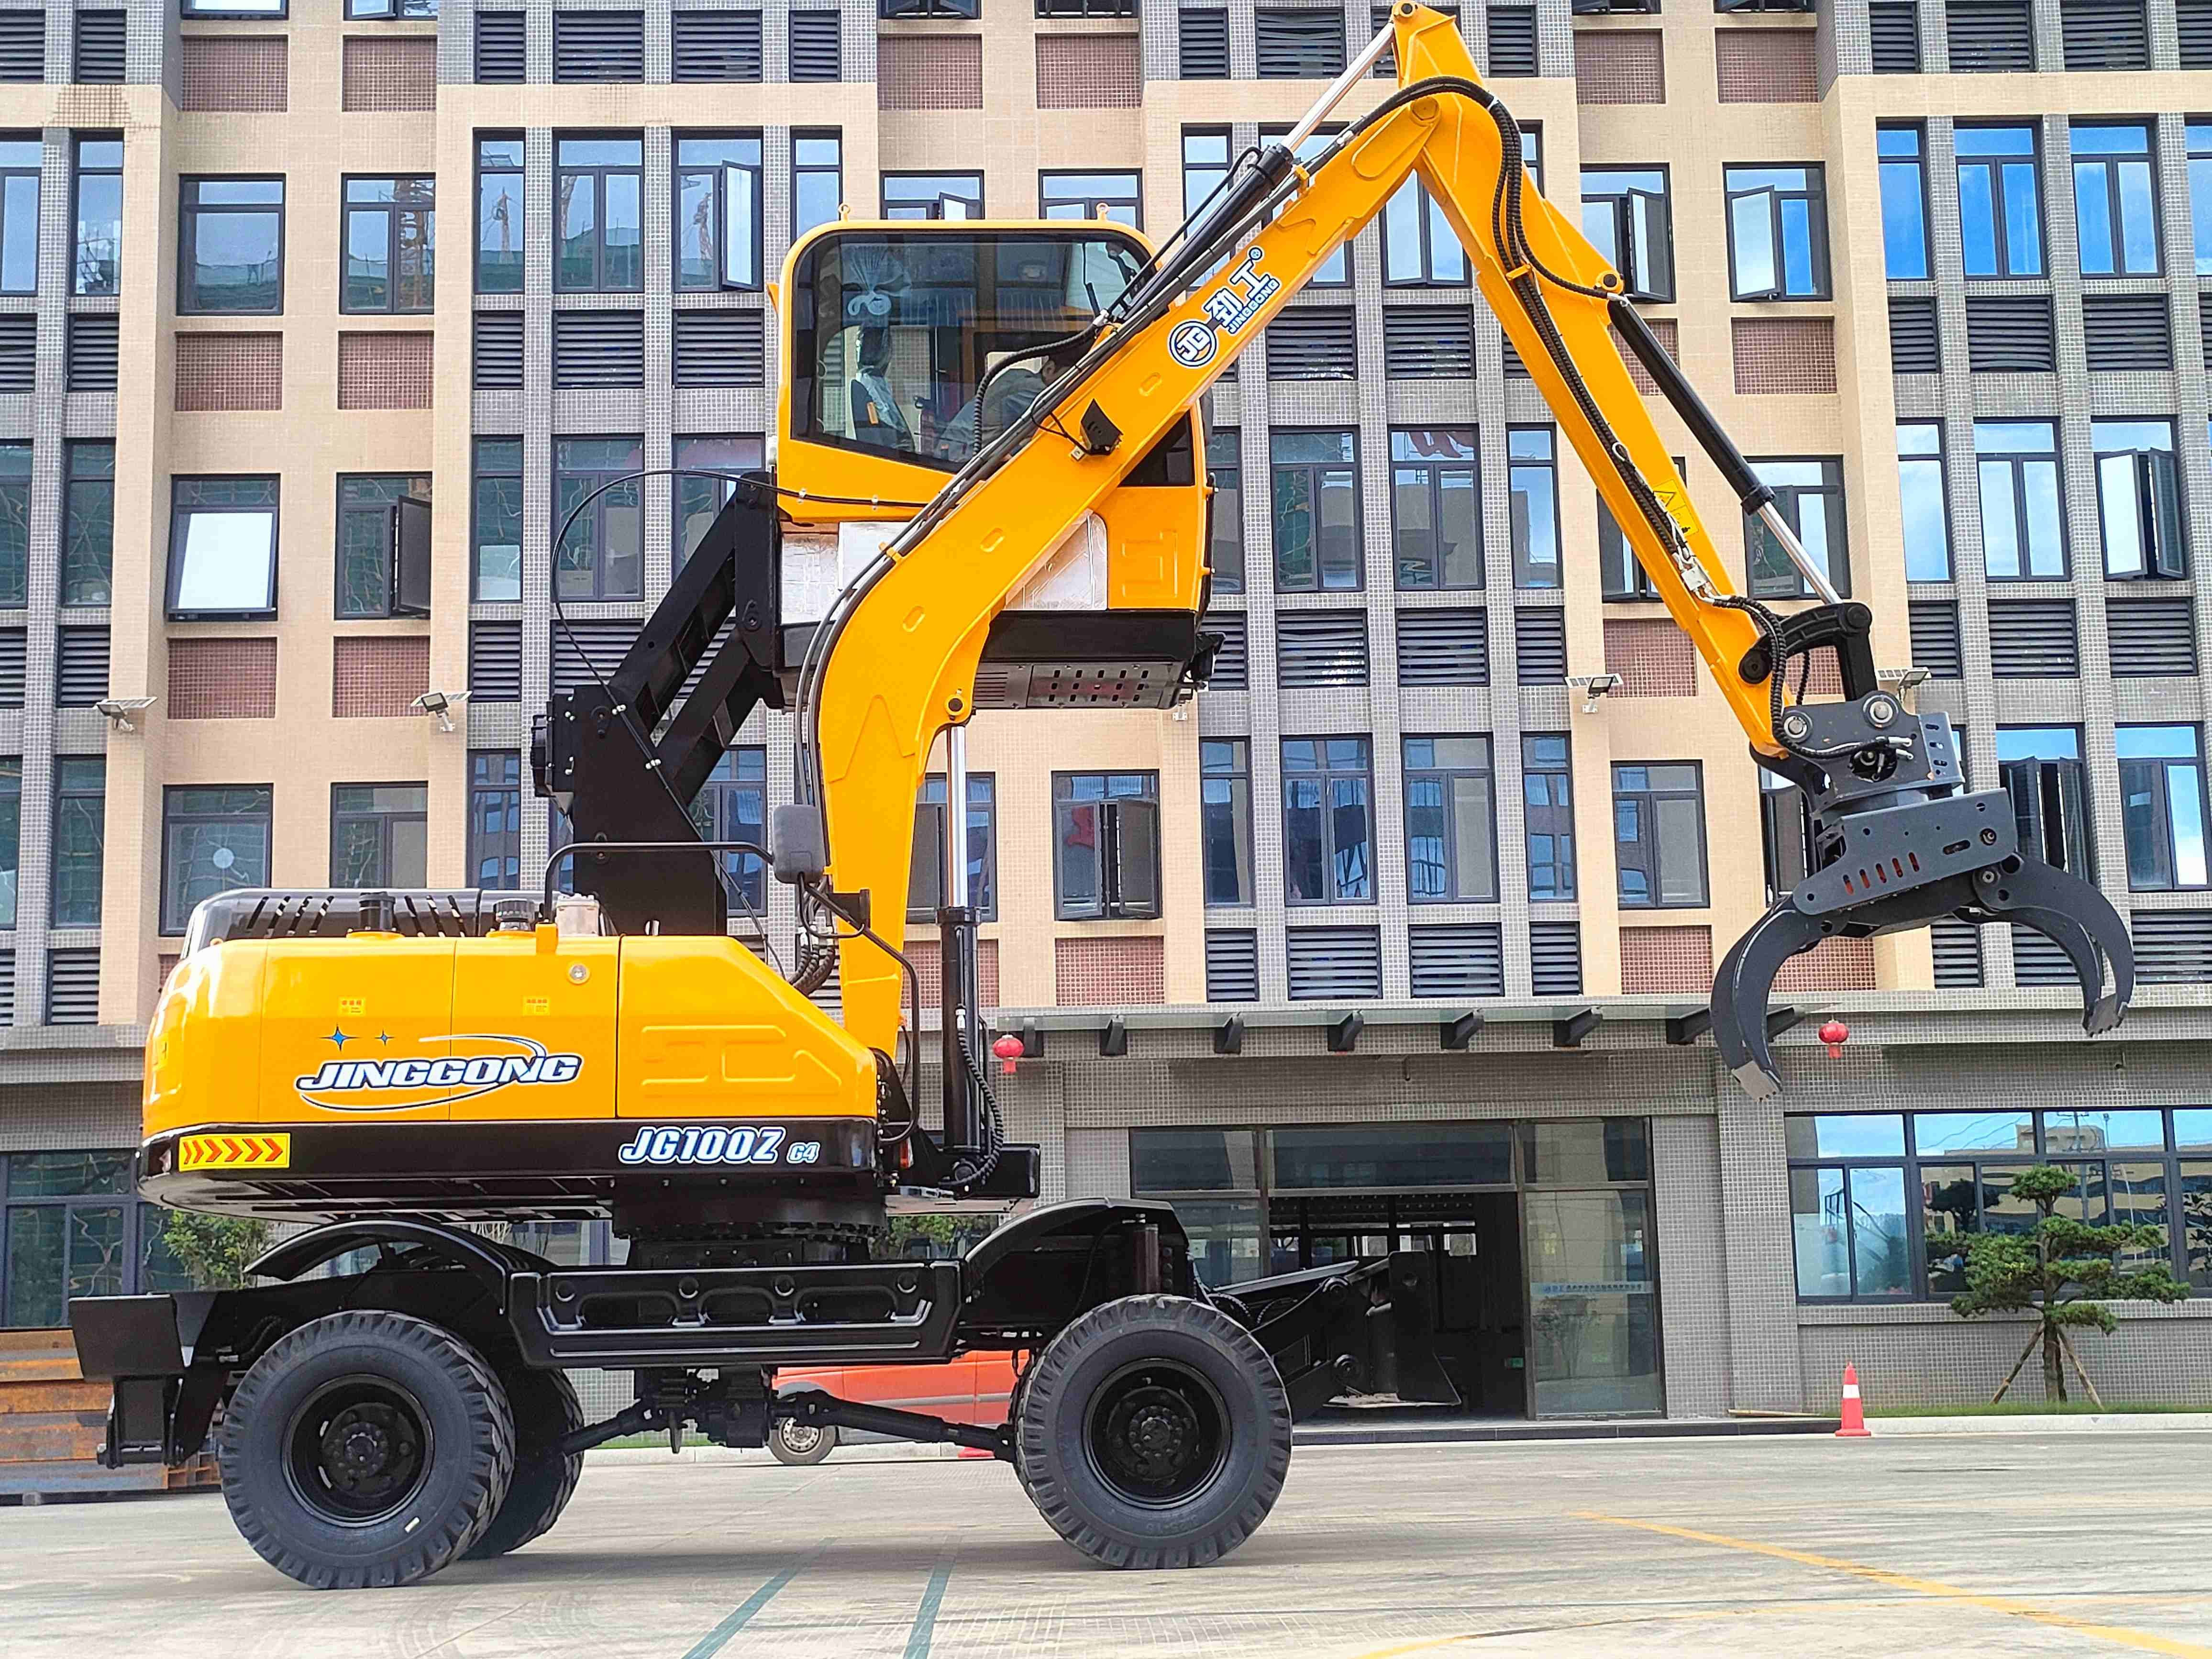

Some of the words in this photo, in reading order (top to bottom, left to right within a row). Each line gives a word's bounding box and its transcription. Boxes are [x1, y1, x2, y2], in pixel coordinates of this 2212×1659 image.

[1227, 279, 1280, 334] JINGGONG
[1175, 325, 1212, 362] JG
[296, 1055, 581, 1090] JINGGONG
[619, 1127, 785, 1164] JG100Z
